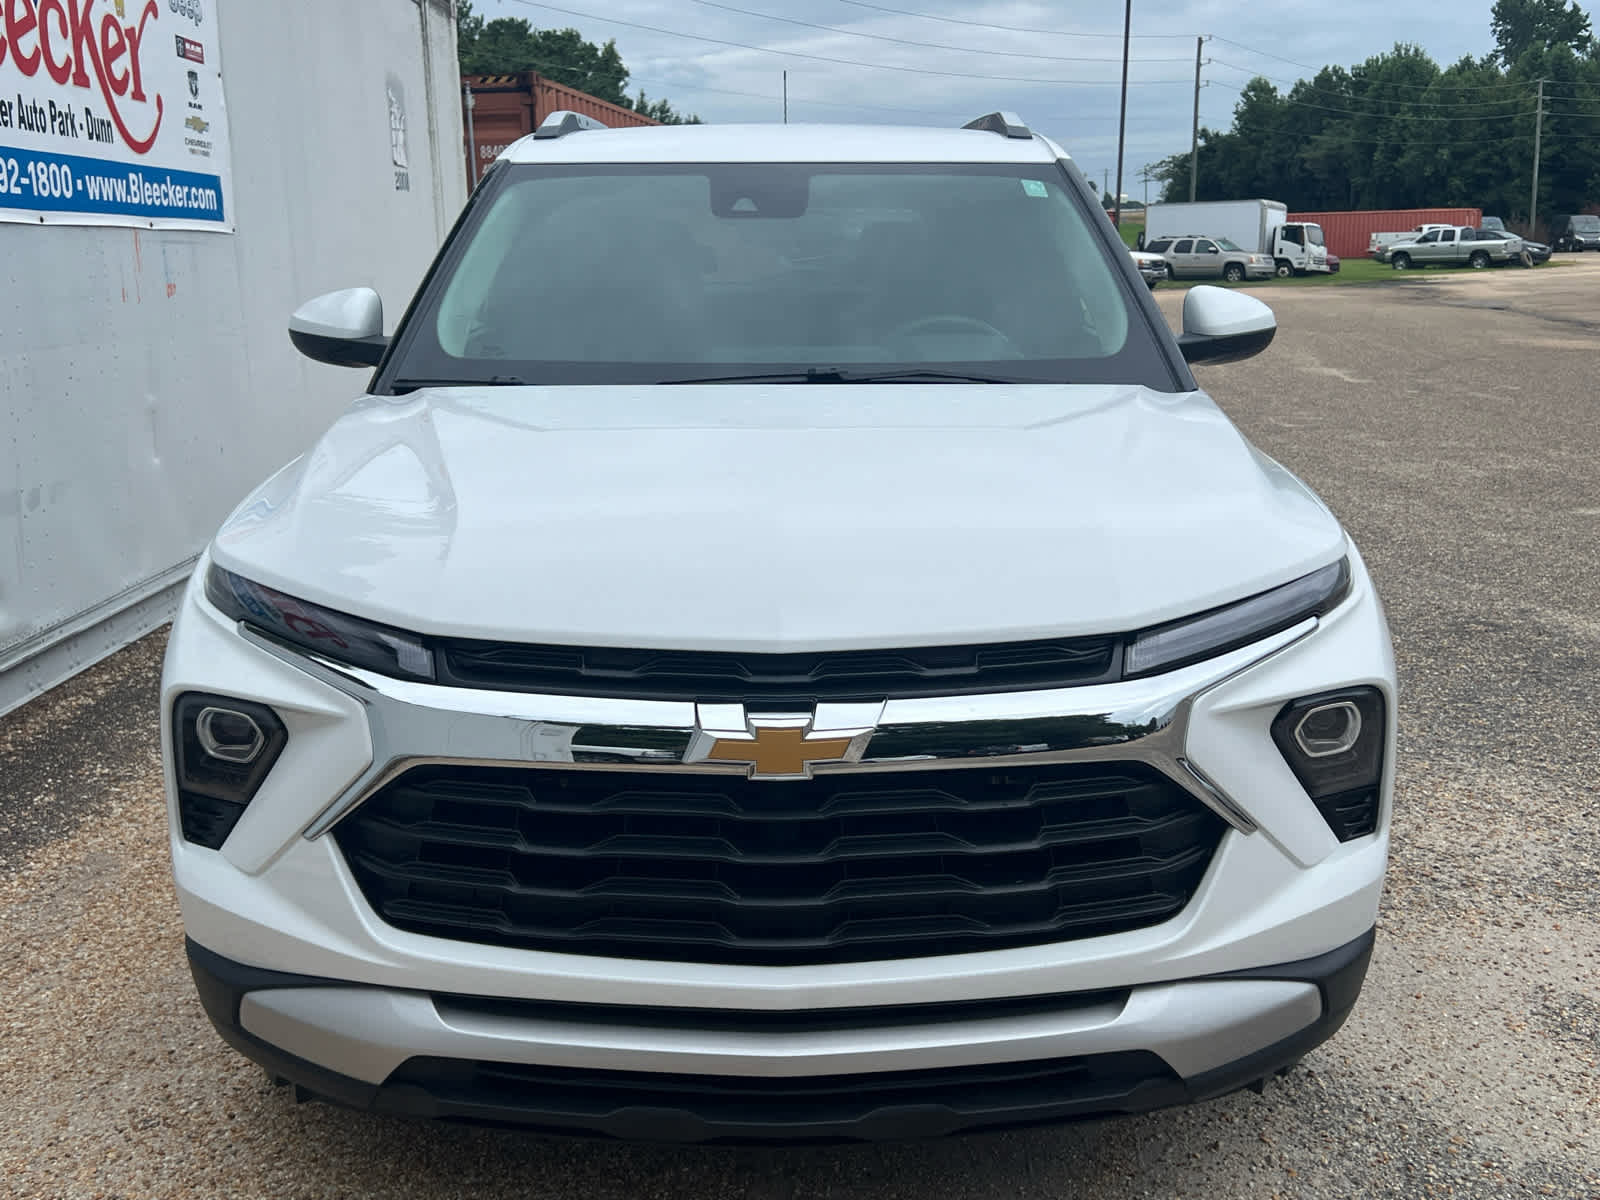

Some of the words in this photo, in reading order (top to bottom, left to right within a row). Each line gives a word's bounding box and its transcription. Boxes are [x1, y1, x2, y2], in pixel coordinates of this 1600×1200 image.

[0, 98, 14, 128] er
[17, 93, 47, 135] Auto
[48, 99, 79, 139] Park
[85, 107, 115, 145] Dunn
[85, 172, 218, 211] www.Bleecker.com
